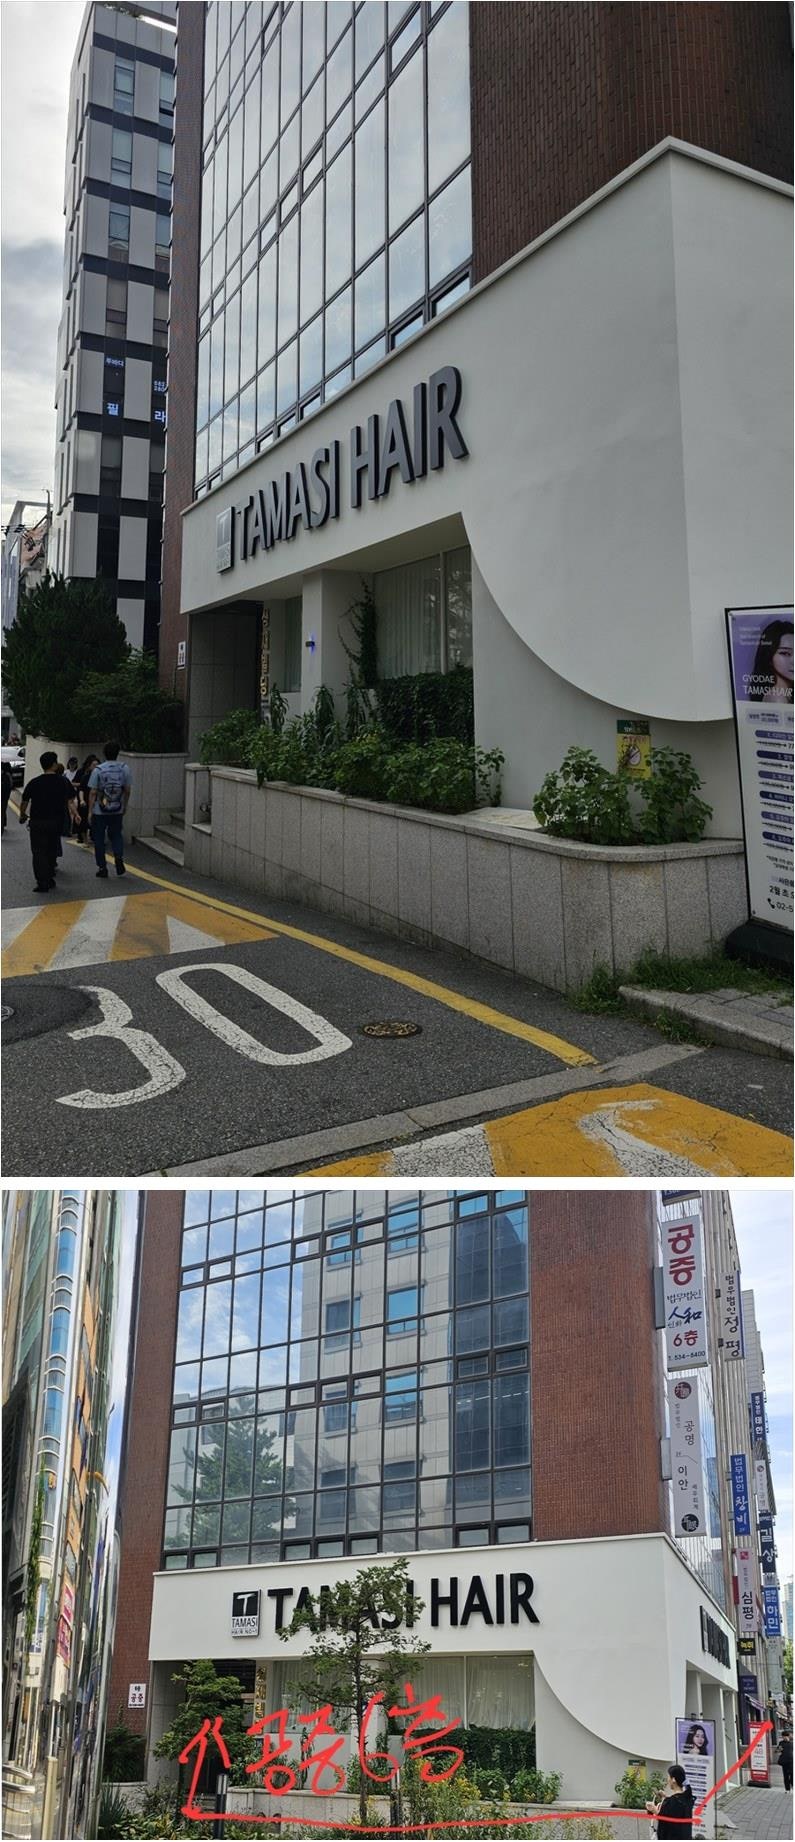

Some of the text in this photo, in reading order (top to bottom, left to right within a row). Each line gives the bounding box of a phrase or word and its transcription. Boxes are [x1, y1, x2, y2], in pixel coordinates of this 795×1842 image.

[236, 365, 469, 561] TAMASI HAIR
[742, 674, 775, 684] GYODAE
[743, 685, 771, 697] TAMASI
[56, 963, 353, 1109] 30
[668, 1223, 696, 1286] 공증
[667, 1289, 702, 1304] 법무법인
[724, 1275, 741, 1357] 법무법인 정평
[673, 1330, 698, 1347] 6층
[684, 1420, 695, 1446] 공명
[678, 1464, 689, 1491] 이안
[734, 1457, 744, 1492] 법무법인
[430, 1573, 540, 1627] HAIR
[742, 1591, 754, 1620] 심평
[231, 1616, 258, 1628] TAMASI
[767, 1605, 779, 1630] 하민
